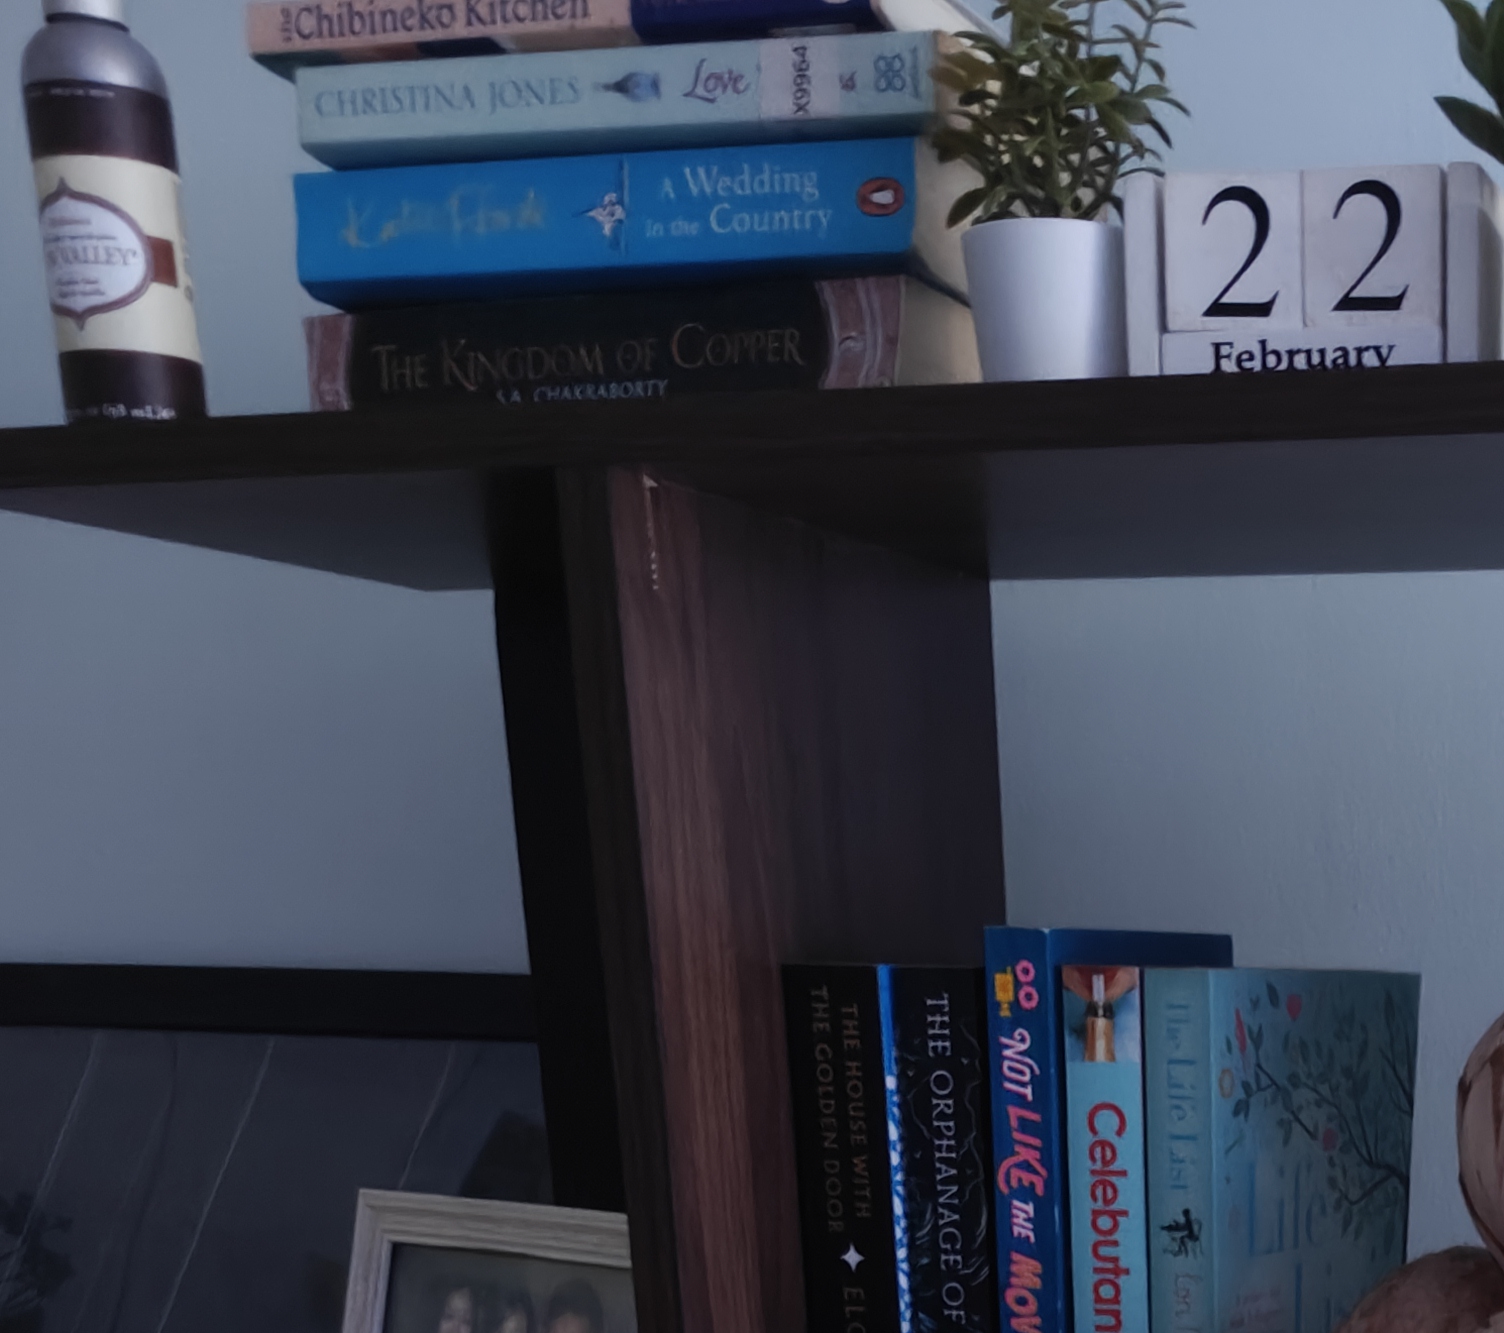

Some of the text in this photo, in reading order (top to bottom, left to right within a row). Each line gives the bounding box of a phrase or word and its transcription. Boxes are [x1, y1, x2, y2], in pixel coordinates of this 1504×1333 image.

[294, 0, 589, 40] Chibineko Kitchen
[314, 75, 580, 117] CHRISTINA JONES
[683, 57, 750, 103] Love
[660, 163, 819, 201] A Wedding
[671, 203, 832, 238] the Country
[373, 321, 806, 393] THE KINGDOM OF COPPER
[1211, 338, 1397, 373] February
[925, 991, 951, 1057] THE
[999, 1027, 1040, 1101] NOT
[811, 985, 844, 1233] THE GOLDEN DOOR
[841, 1004, 872, 1218] THE HOUSE WITH
[1166, 1058, 1198, 1191] Life List
[930, 1070, 963, 1271] ORPHANAGE
[997, 1105, 1047, 1198] LIKE
[1010, 1199, 1035, 1243] THE
[942, 1282, 966, 1325] OF
